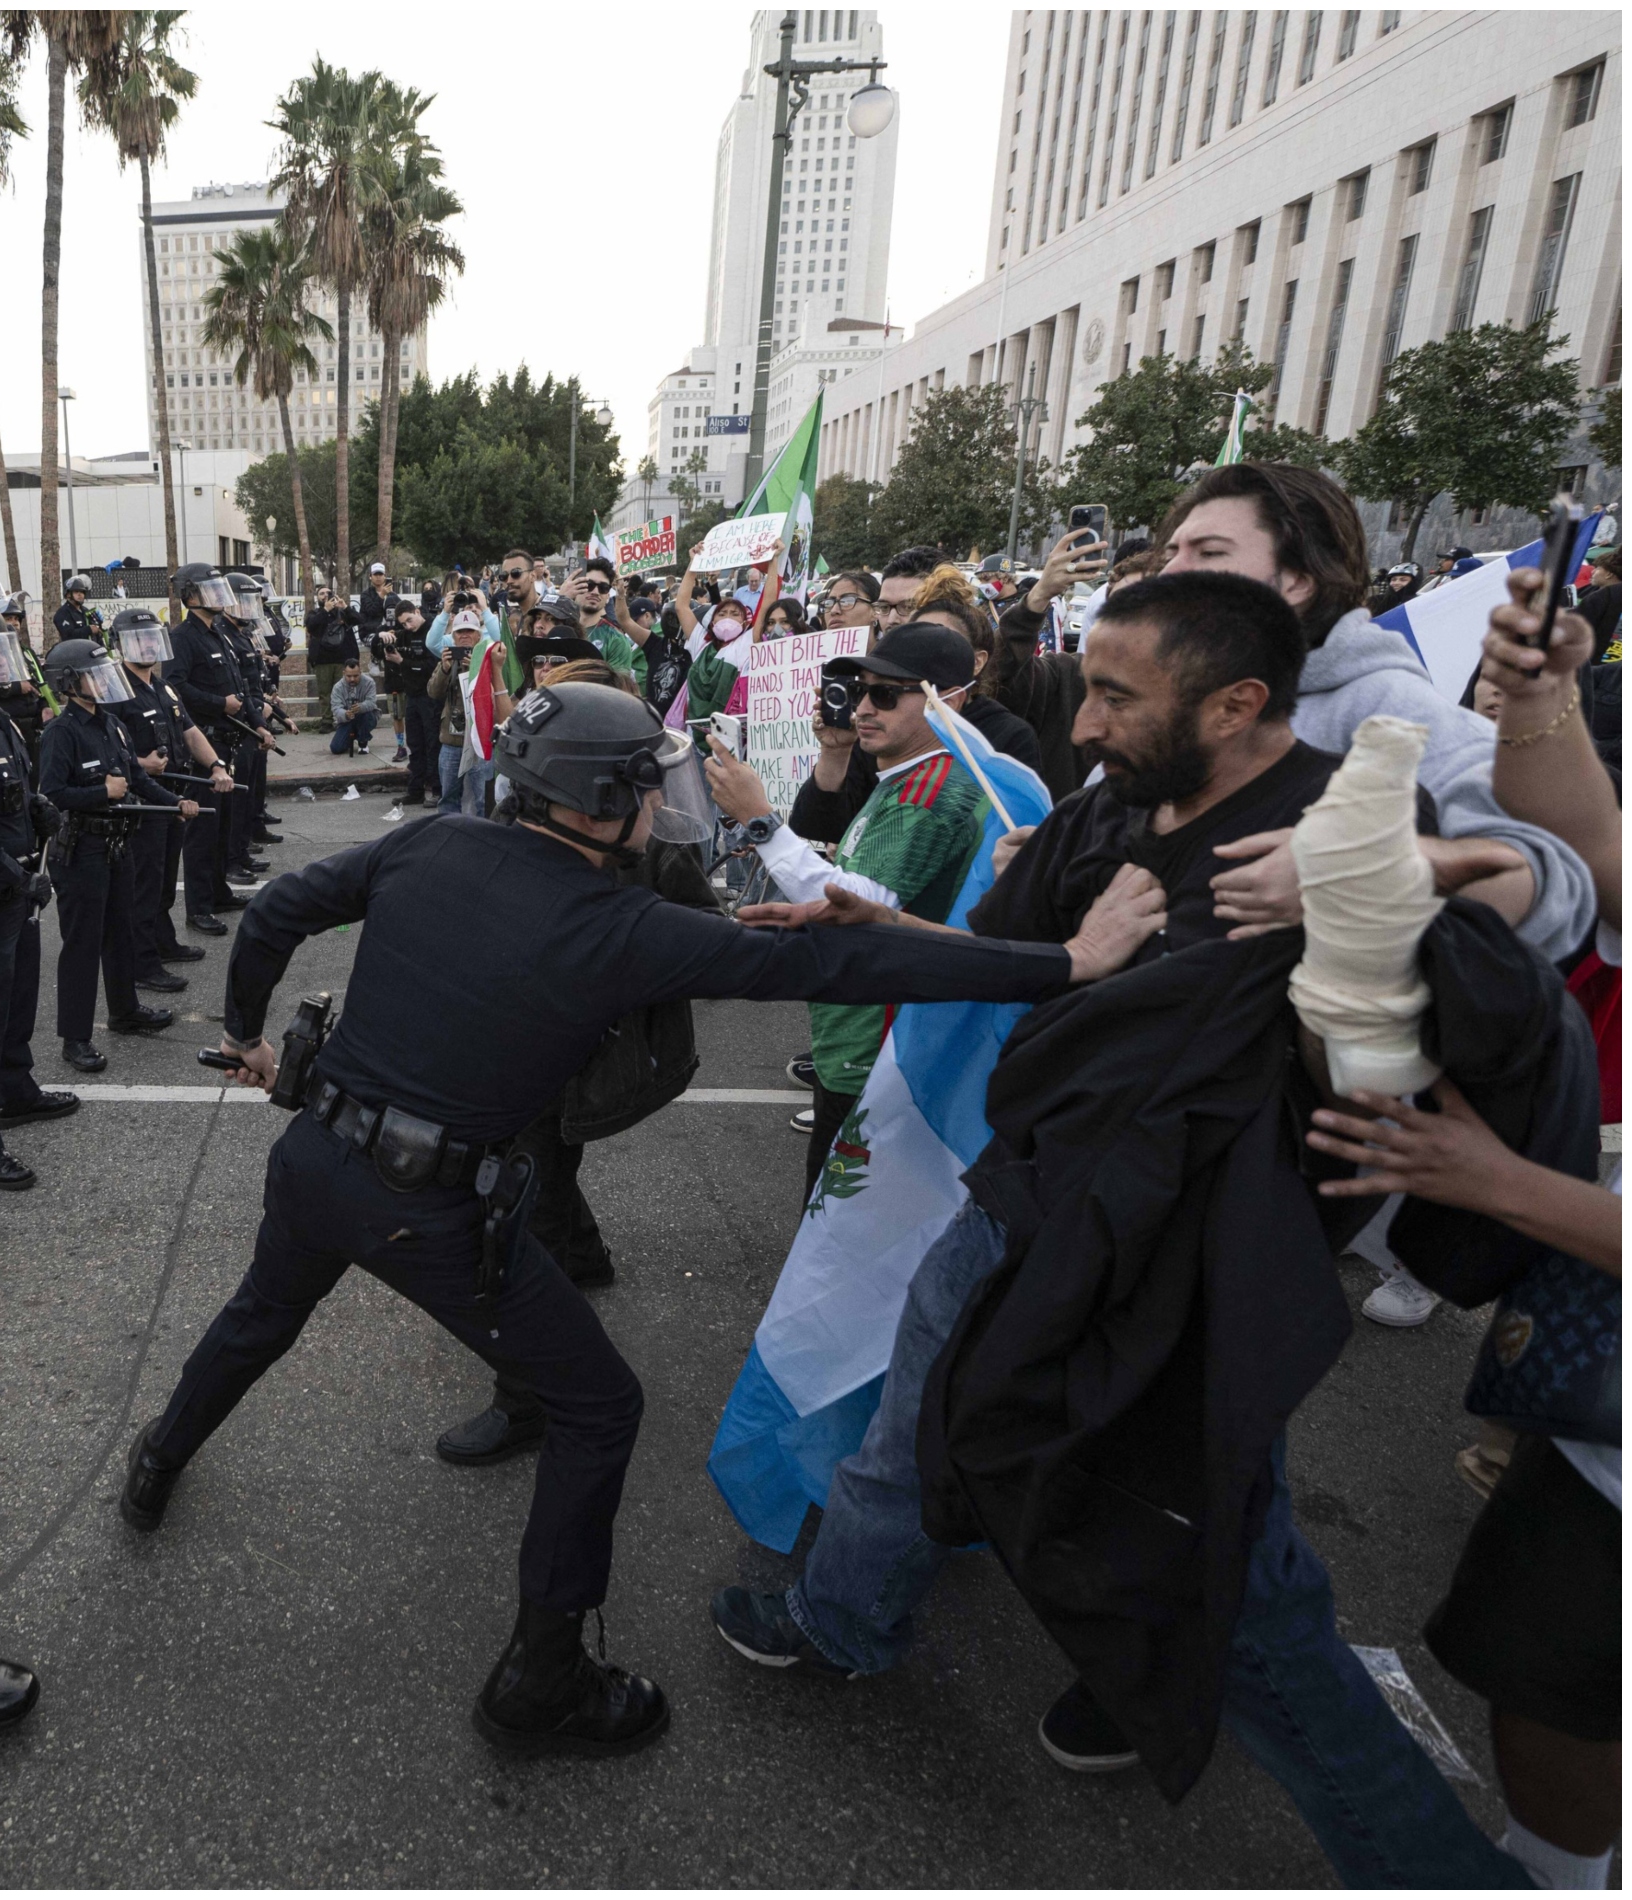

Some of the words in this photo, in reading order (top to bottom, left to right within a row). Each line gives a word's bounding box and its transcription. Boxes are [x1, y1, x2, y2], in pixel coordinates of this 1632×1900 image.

[709, 416, 730, 427] Aliso
[737, 416, 747, 427] St
[709, 426, 719, 434] 100
[721, 426, 725, 434] E
[619, 527, 644, 545] THE
[727, 522, 745, 539] AM
[749, 518, 778, 535] HERE
[620, 532, 675, 564] BORDER
[708, 535, 756, 557] BECAUSE
[619, 553, 667, 576] CROSSED
[463, 614, 469, 622] A
[750, 641, 787, 671] DONT
[791, 632, 827, 664] BITE
[831, 629, 861, 656] THE
[749, 671, 784, 695] HANDS
[789, 665, 822, 691] THAT
[753, 697, 781, 722] FEED
[788, 691, 818, 720] YOU
[749, 757, 784, 780] MAKE
[792, 755, 821, 780] AME
[768, 780, 805, 806] GREA
